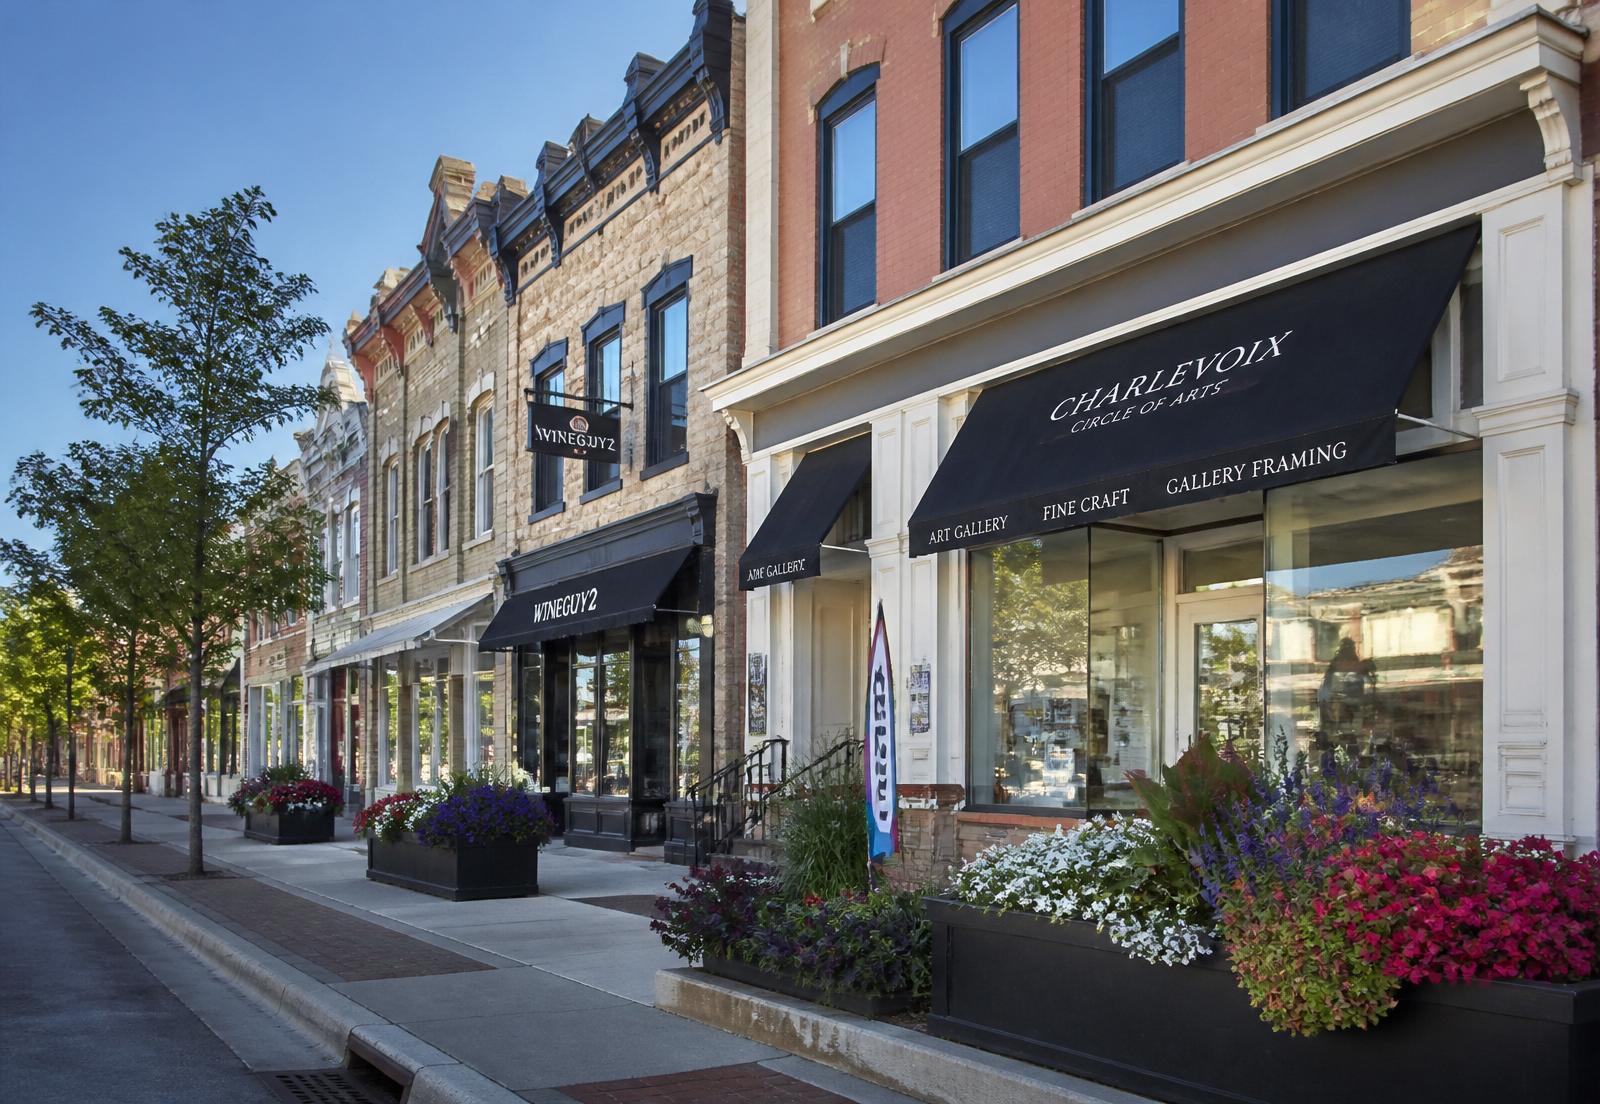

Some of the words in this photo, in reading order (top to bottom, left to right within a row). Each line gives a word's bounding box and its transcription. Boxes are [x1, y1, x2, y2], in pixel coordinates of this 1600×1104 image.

[1050, 330, 1293, 421] CHARLEVOIX
[1071, 405, 1136, 433] CIRCLE
[1140, 397, 1167, 415] OF
[1169, 379, 1229, 407] ARTS
[1166, 463, 1246, 495] GALLERY
[1252, 441, 1347, 478] FRAMING
[928, 527, 951, 545] ART
[954, 515, 1008, 539] GALLERY
[1042, 500, 1076, 521] FINE
[1080, 489, 1131, 513] CRAFT
